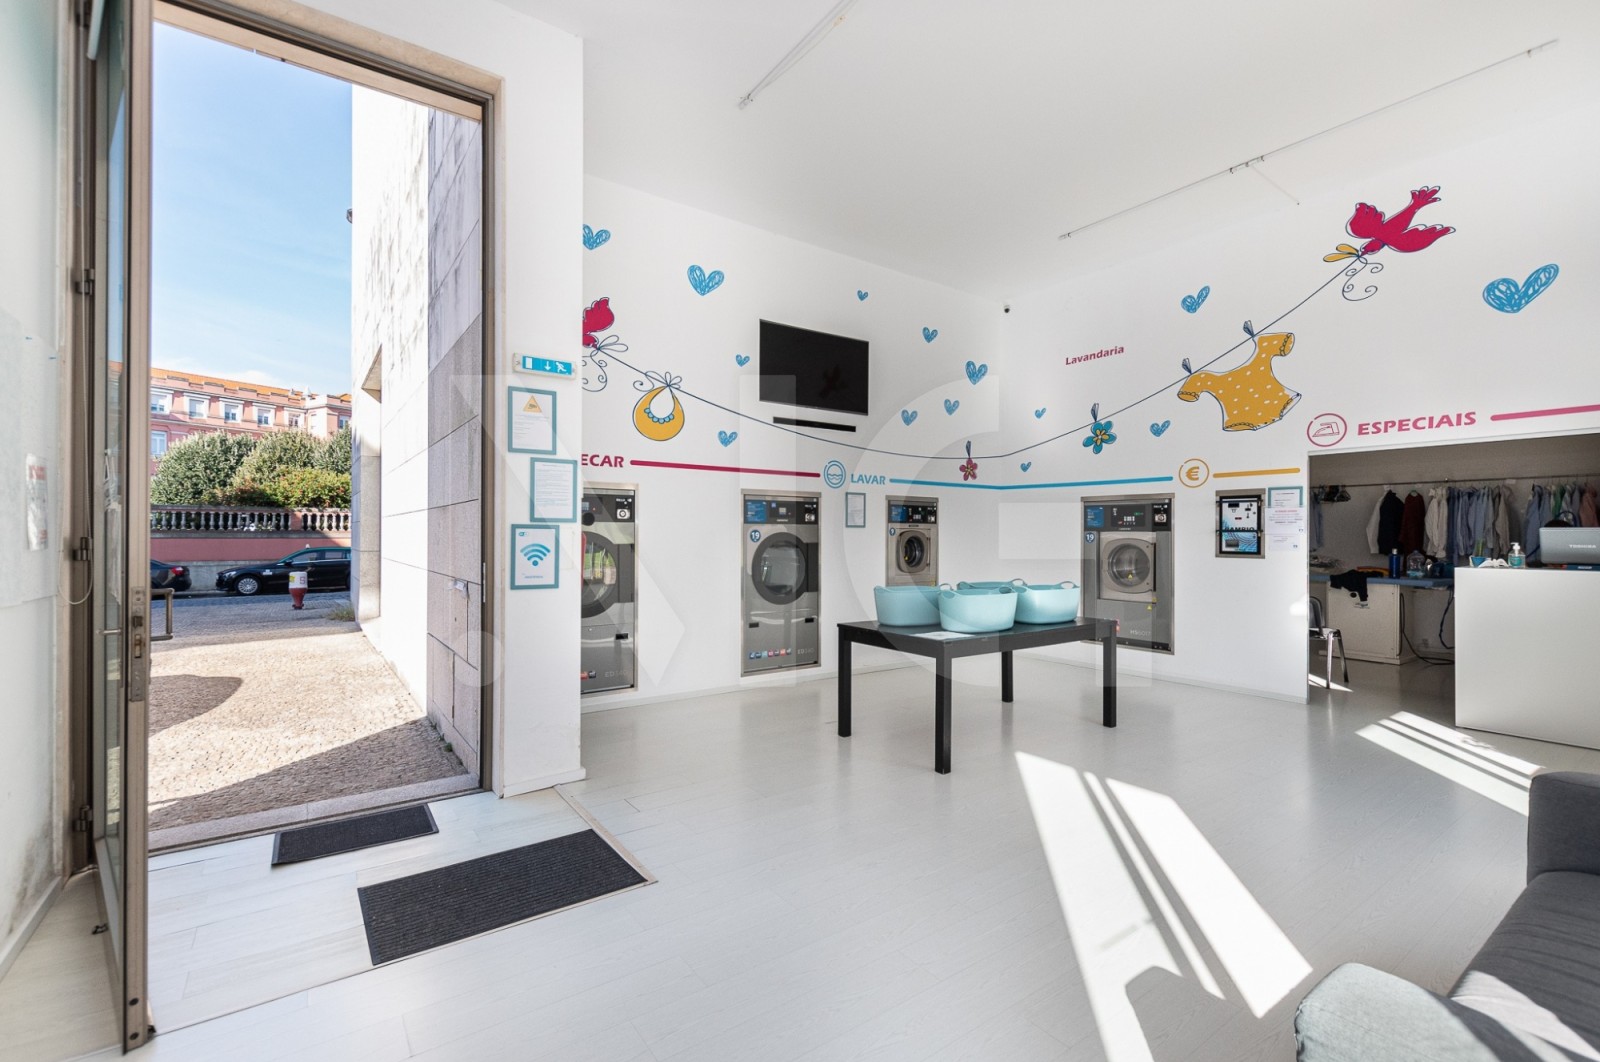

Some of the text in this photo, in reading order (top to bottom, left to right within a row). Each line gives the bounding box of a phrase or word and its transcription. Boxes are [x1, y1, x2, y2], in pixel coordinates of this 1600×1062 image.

[1065, 345, 1125, 366] Lavandaria
[1357, 411, 1477, 436] ESPECIAIS
[850, 473, 886, 485] LAVAR
[751, 531, 760, 540] 19
